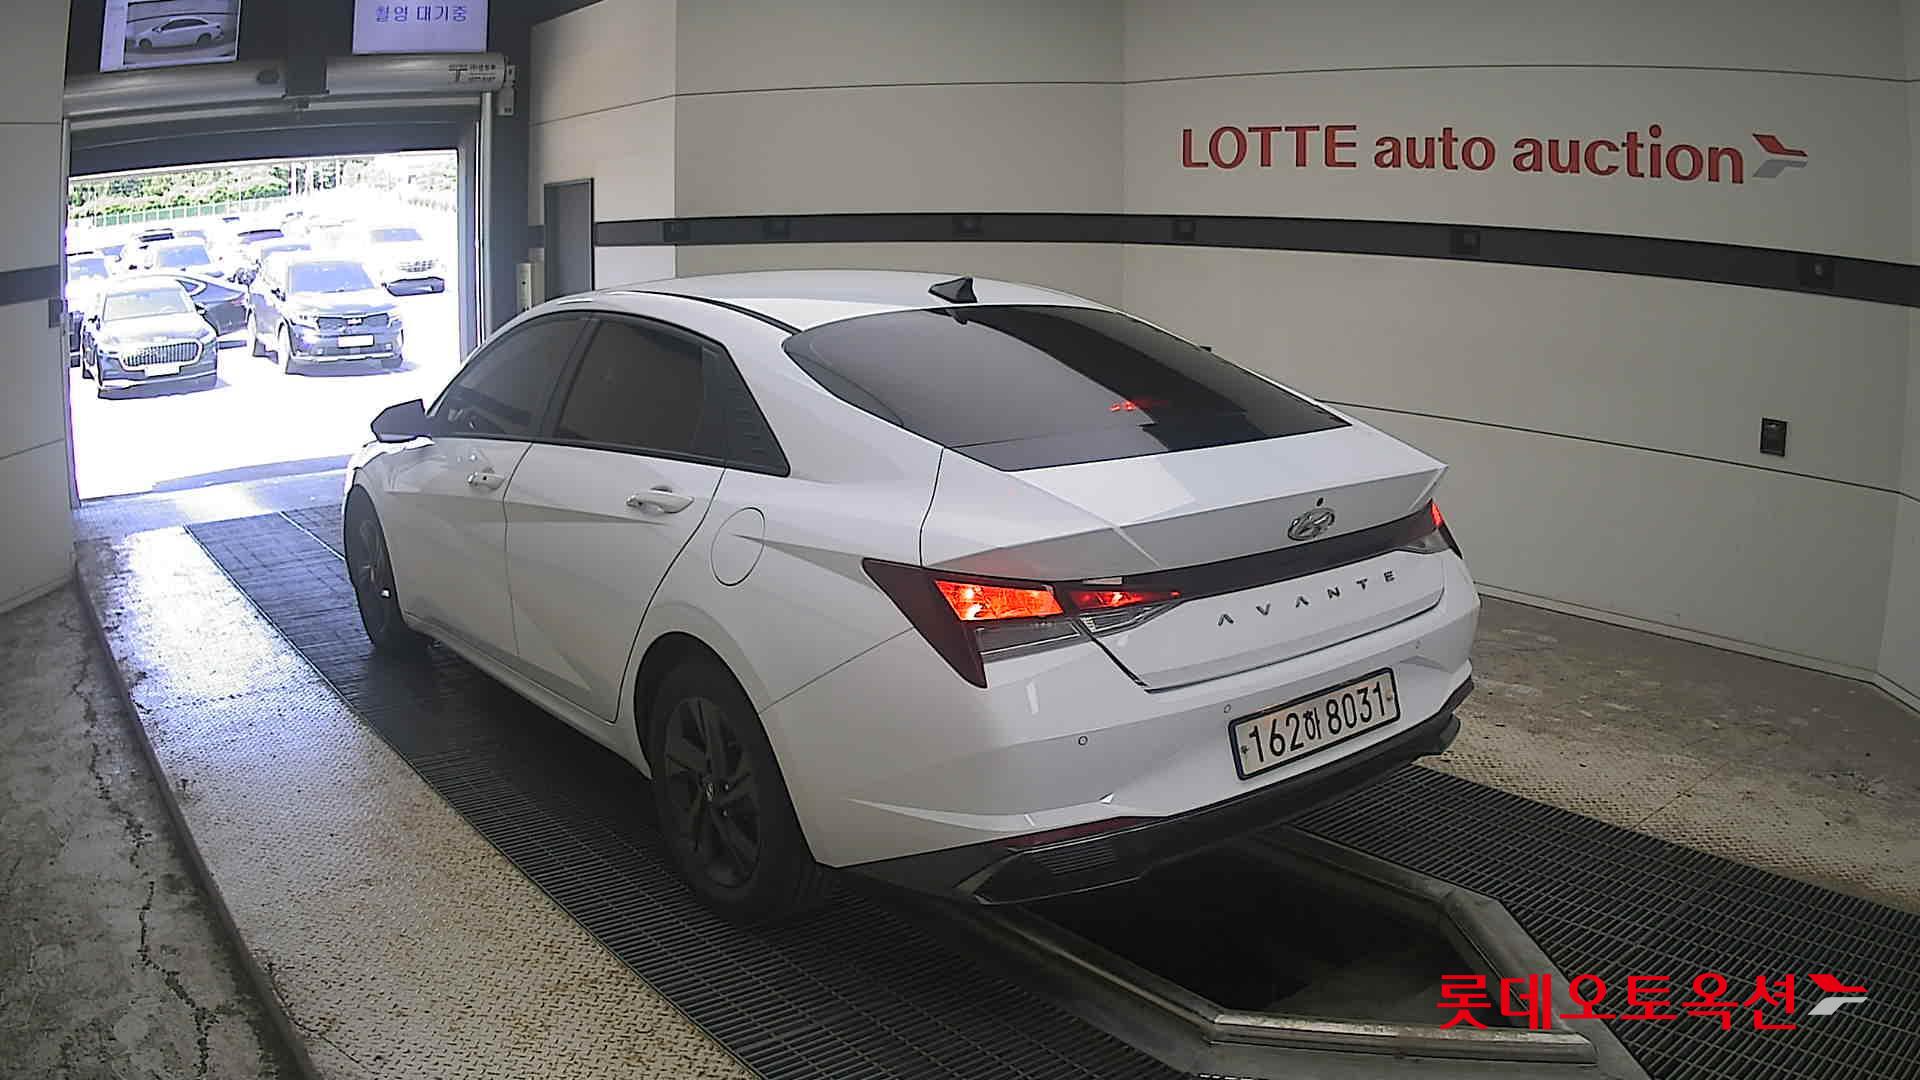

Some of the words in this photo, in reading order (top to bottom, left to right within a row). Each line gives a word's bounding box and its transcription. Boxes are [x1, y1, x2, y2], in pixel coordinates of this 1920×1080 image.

[1182, 124, 1358, 169] LOTTE
[1373, 127, 1496, 171] auto
[1512, 123, 1744, 185] auction
[1217, 570, 1395, 626] AVANTE
